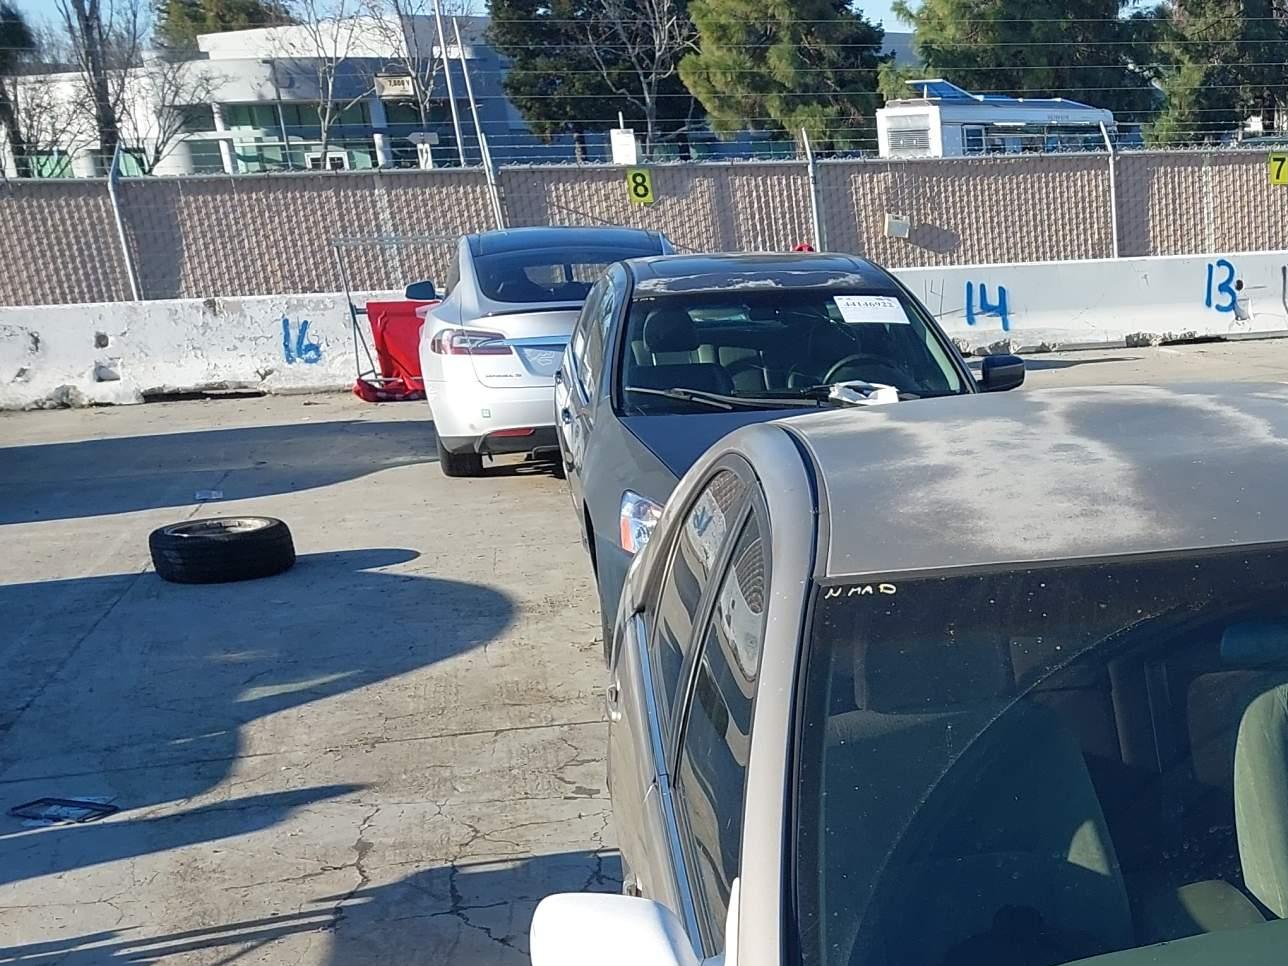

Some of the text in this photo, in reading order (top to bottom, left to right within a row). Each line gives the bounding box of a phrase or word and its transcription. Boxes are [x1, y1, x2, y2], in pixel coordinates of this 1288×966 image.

[632, 172, 649, 198] 8
[1272, 157, 1286, 180] 7
[966, 280, 1010, 332] 14
[1205, 259, 1237, 312] 13
[282, 318, 322, 364] 16
